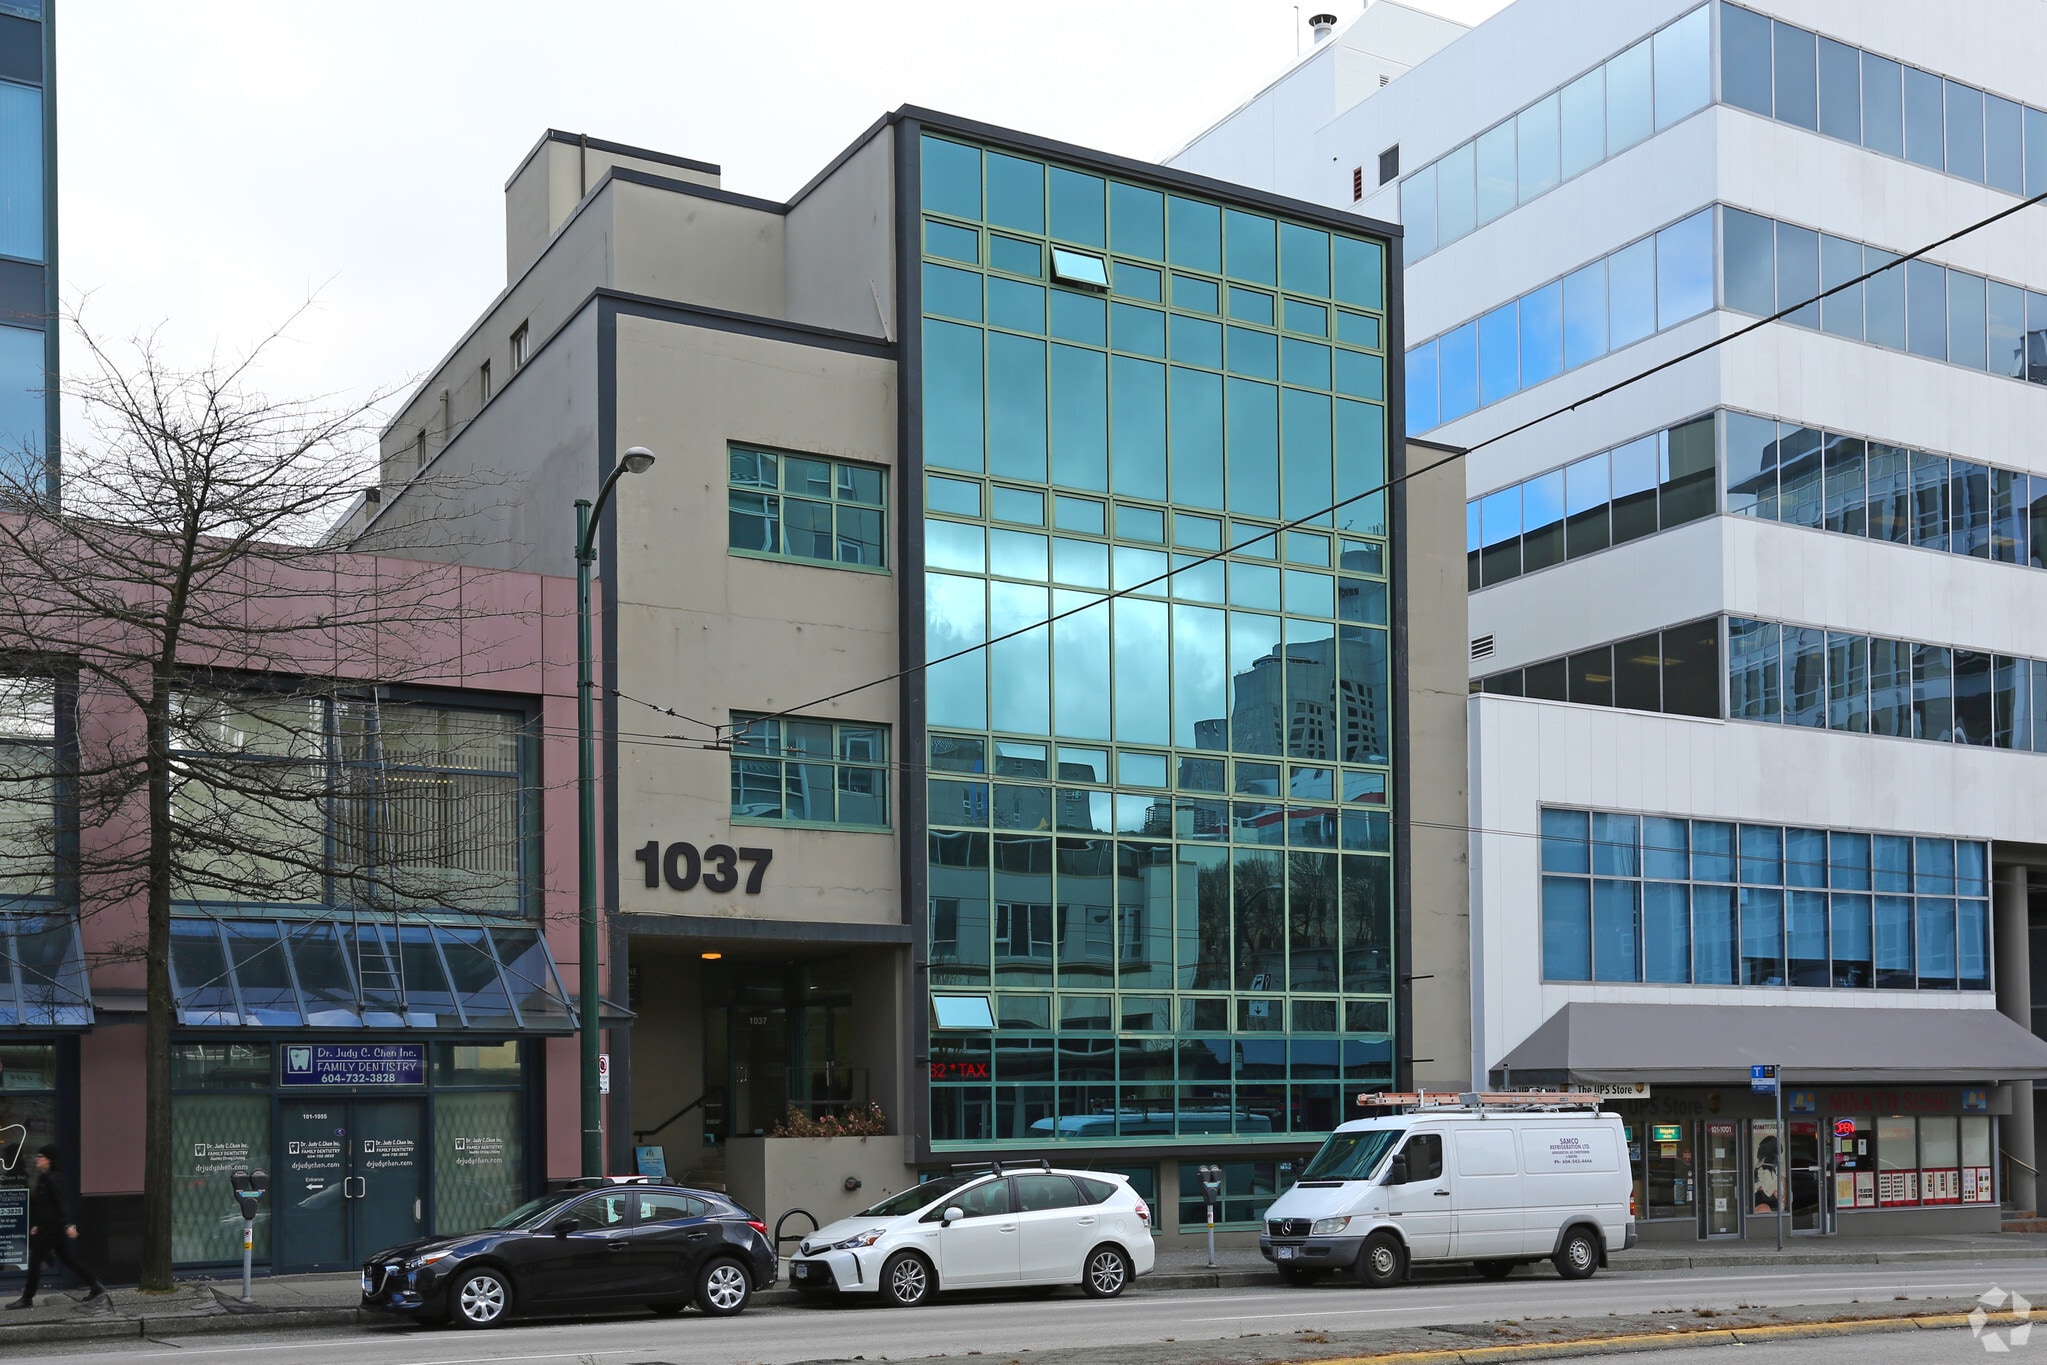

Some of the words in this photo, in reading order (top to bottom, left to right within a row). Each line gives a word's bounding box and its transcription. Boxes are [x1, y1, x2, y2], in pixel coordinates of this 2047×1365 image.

[636, 840, 772, 894] 1037
[749, 1016, 767, 1024] 1037
[318, 1048, 332, 1058] Dr.
[336, 1048, 358, 1059] Judy
[361, 1048, 370, 1057] C.
[374, 1048, 396, 1057] Chen
[400, 1048, 416, 1057] Inc.
[317, 1062, 355, 1072] FAMILY
[358, 1062, 417, 1072] DENTISTRY
[958, 1062, 988, 1078] TAX
[1754, 1067, 1760, 1076] T
[321, 1074, 396, 1083] 604-732-3828
[1578, 1085, 1592, 1093] The
[1594, 1085, 1610, 1094] UPS
[1612, 1085, 1632, 1094] Store
[1664, 1098, 1702, 1116] Store
[1828, 1092, 1898, 1112] MINATO
[1903, 1091, 1950, 1111] SUSHI
[1834, 1122, 1854, 1133] OPEN
